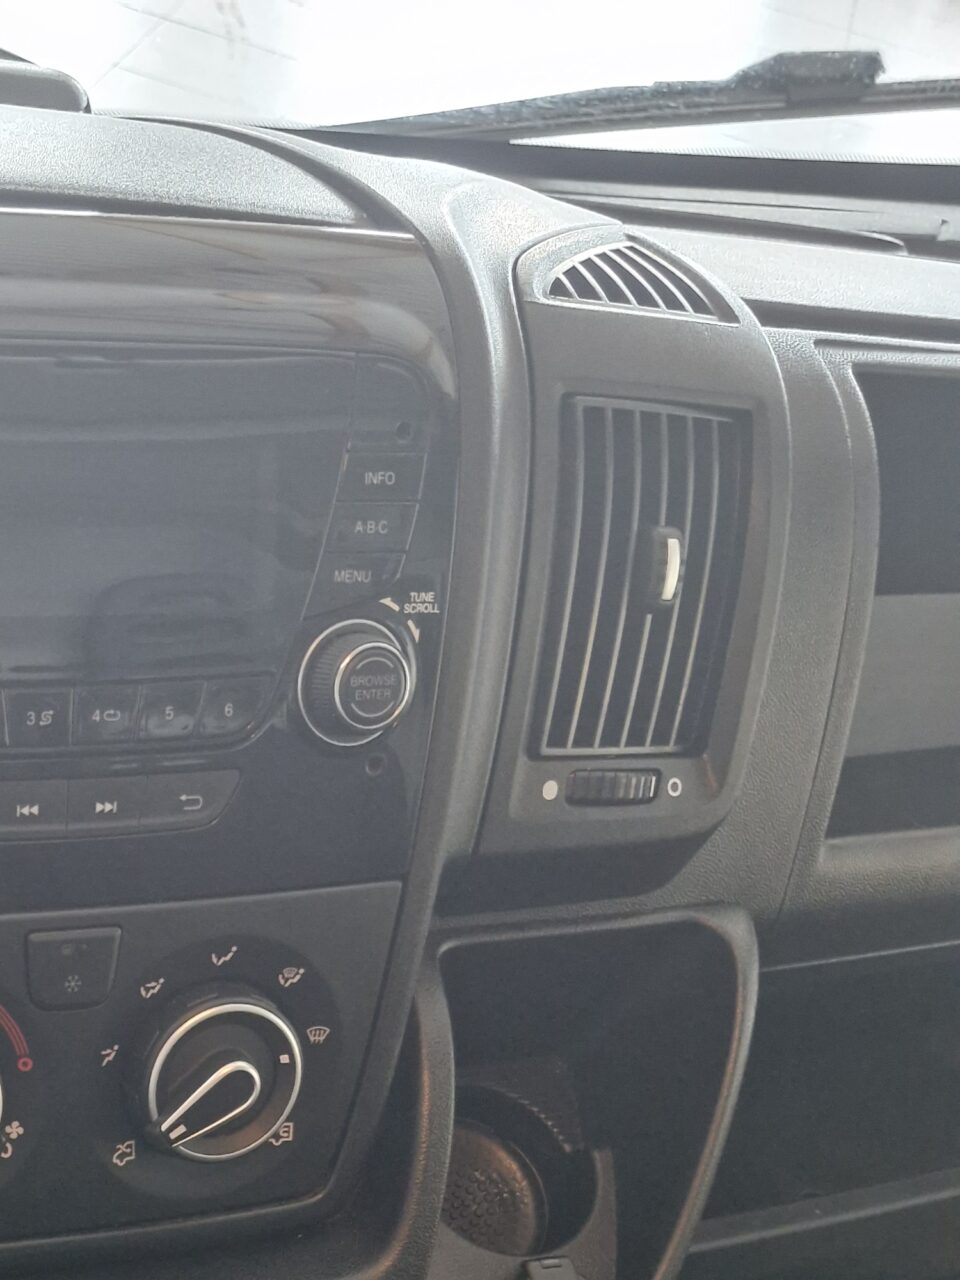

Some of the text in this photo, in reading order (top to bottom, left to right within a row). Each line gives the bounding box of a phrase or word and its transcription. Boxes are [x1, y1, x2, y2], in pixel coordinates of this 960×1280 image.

[364, 471, 396, 485] INFO
[334, 569, 372, 583] MENU
[410, 592, 435, 602] TUNE
[403, 603, 440, 614] SCROLL
[350, 674, 398, 688] BROWSE
[355, 688, 391, 701] ENTER
[91, 709, 102, 724] 4
[164, 705, 175, 721] 5
[223, 703, 234, 718] 6
[26, 711, 36, 726] 3
